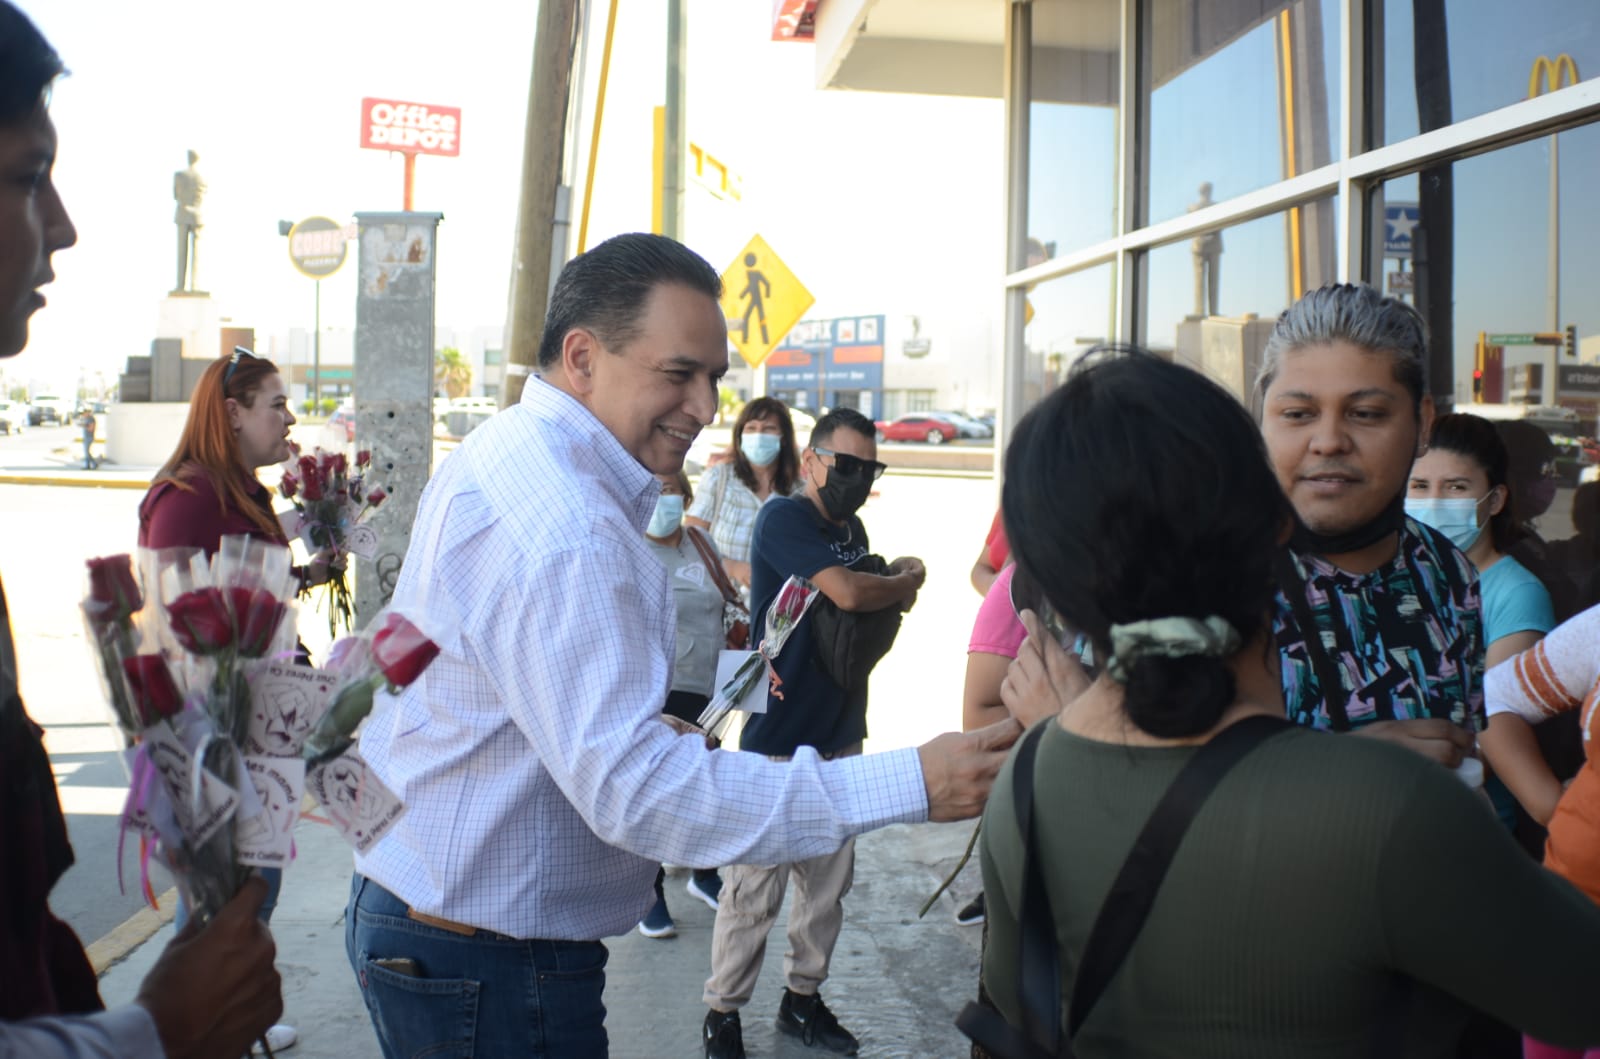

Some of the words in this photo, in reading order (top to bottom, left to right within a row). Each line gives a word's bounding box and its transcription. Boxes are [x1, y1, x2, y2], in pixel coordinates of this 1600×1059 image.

[371, 103, 456, 131] Office
[371, 125, 456, 150] DEPOT
[316, 674, 337, 685] Cruz
